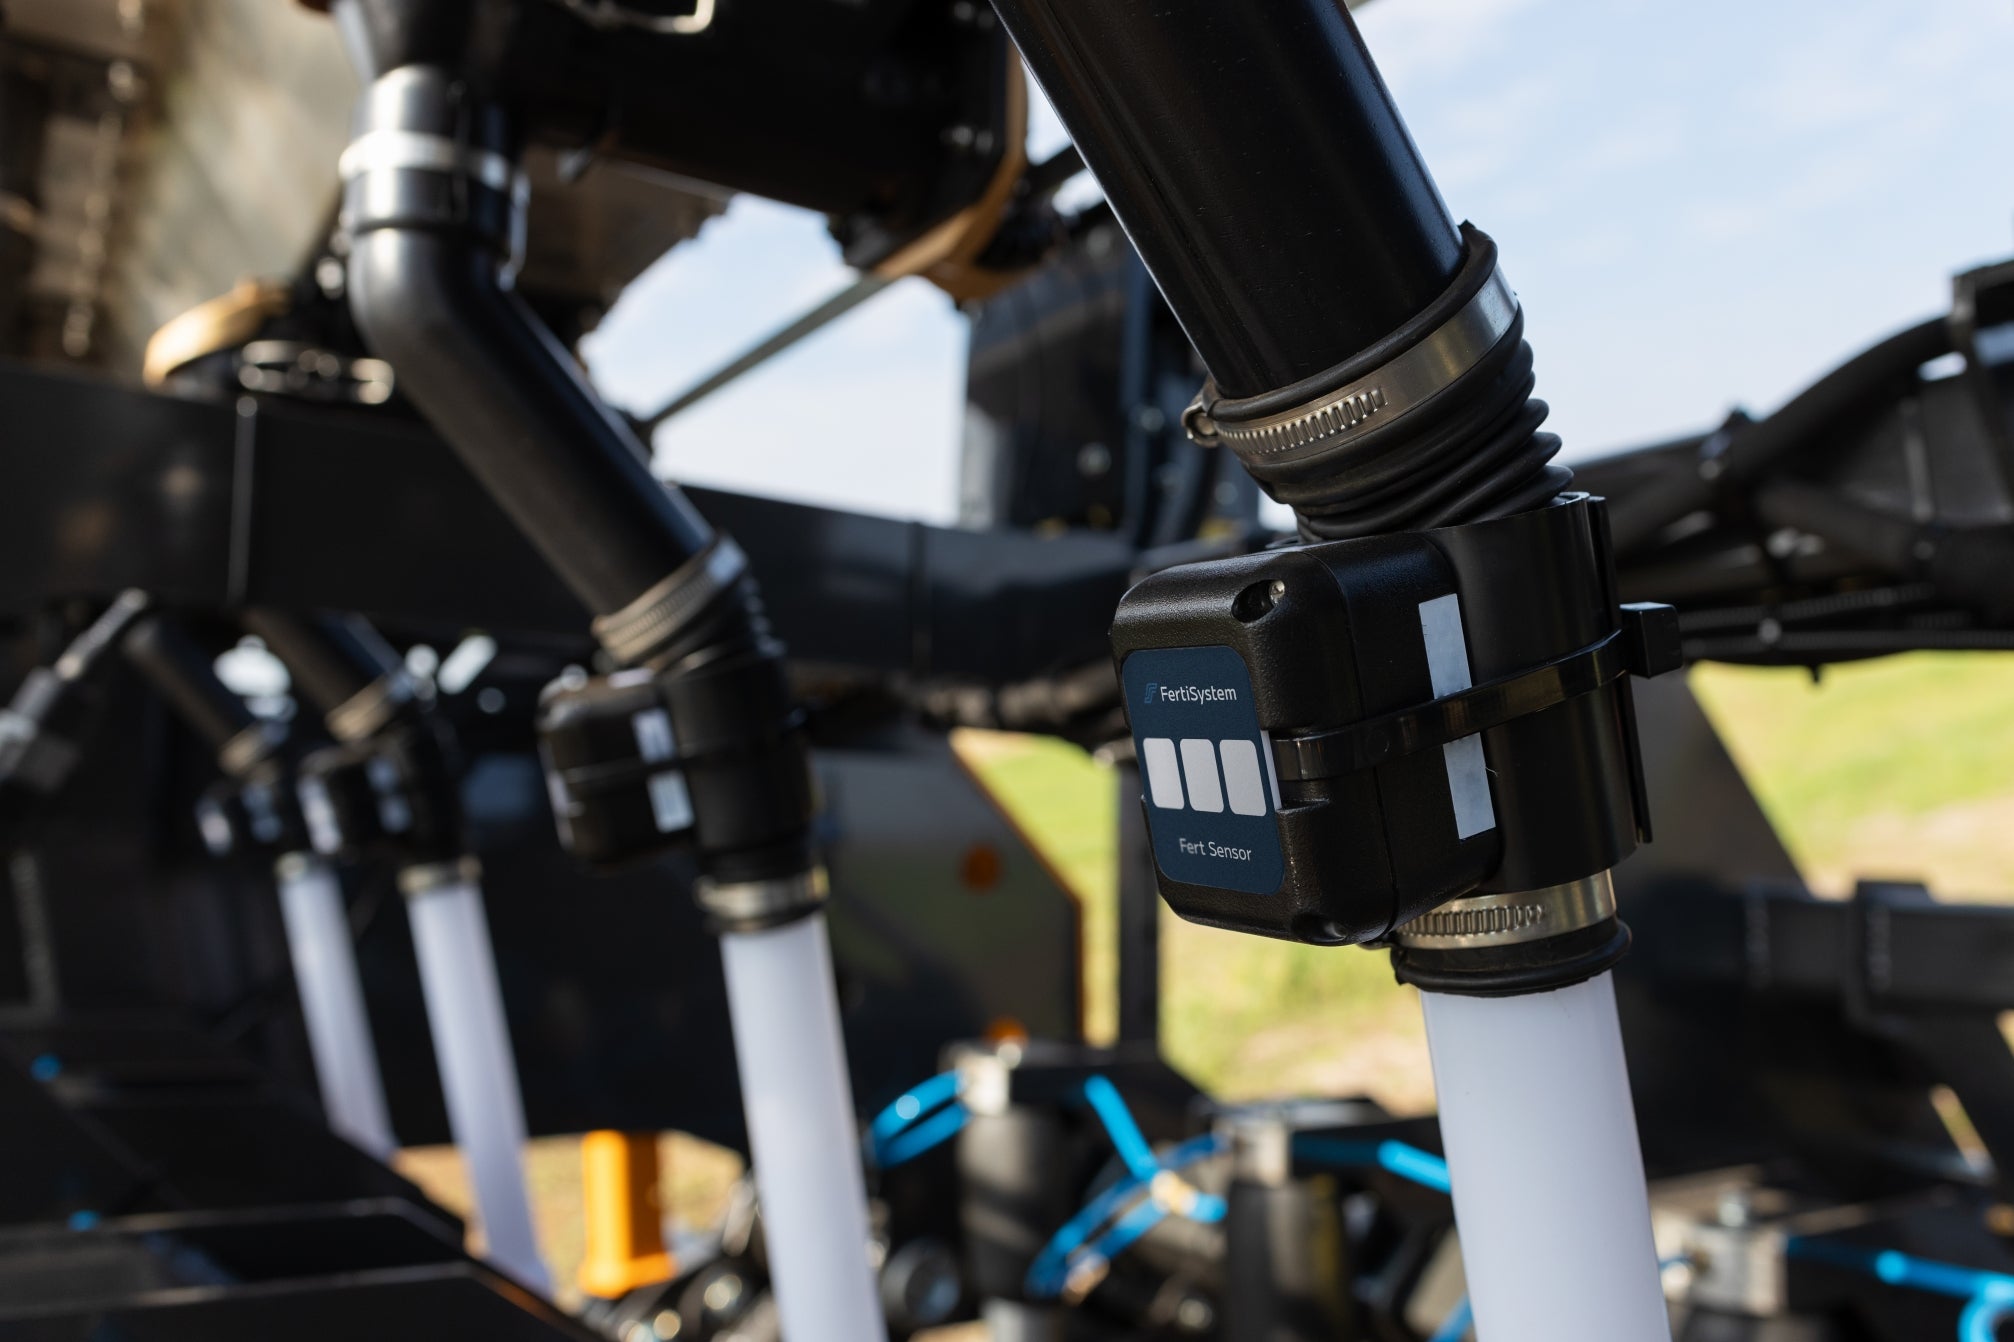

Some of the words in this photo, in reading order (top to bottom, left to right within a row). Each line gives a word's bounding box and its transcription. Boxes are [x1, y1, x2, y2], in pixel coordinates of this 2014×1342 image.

[1160, 685, 1237, 704] FertiSystem
[1179, 838, 1206, 856] Fert
[1208, 841, 1252, 861] Sensor
